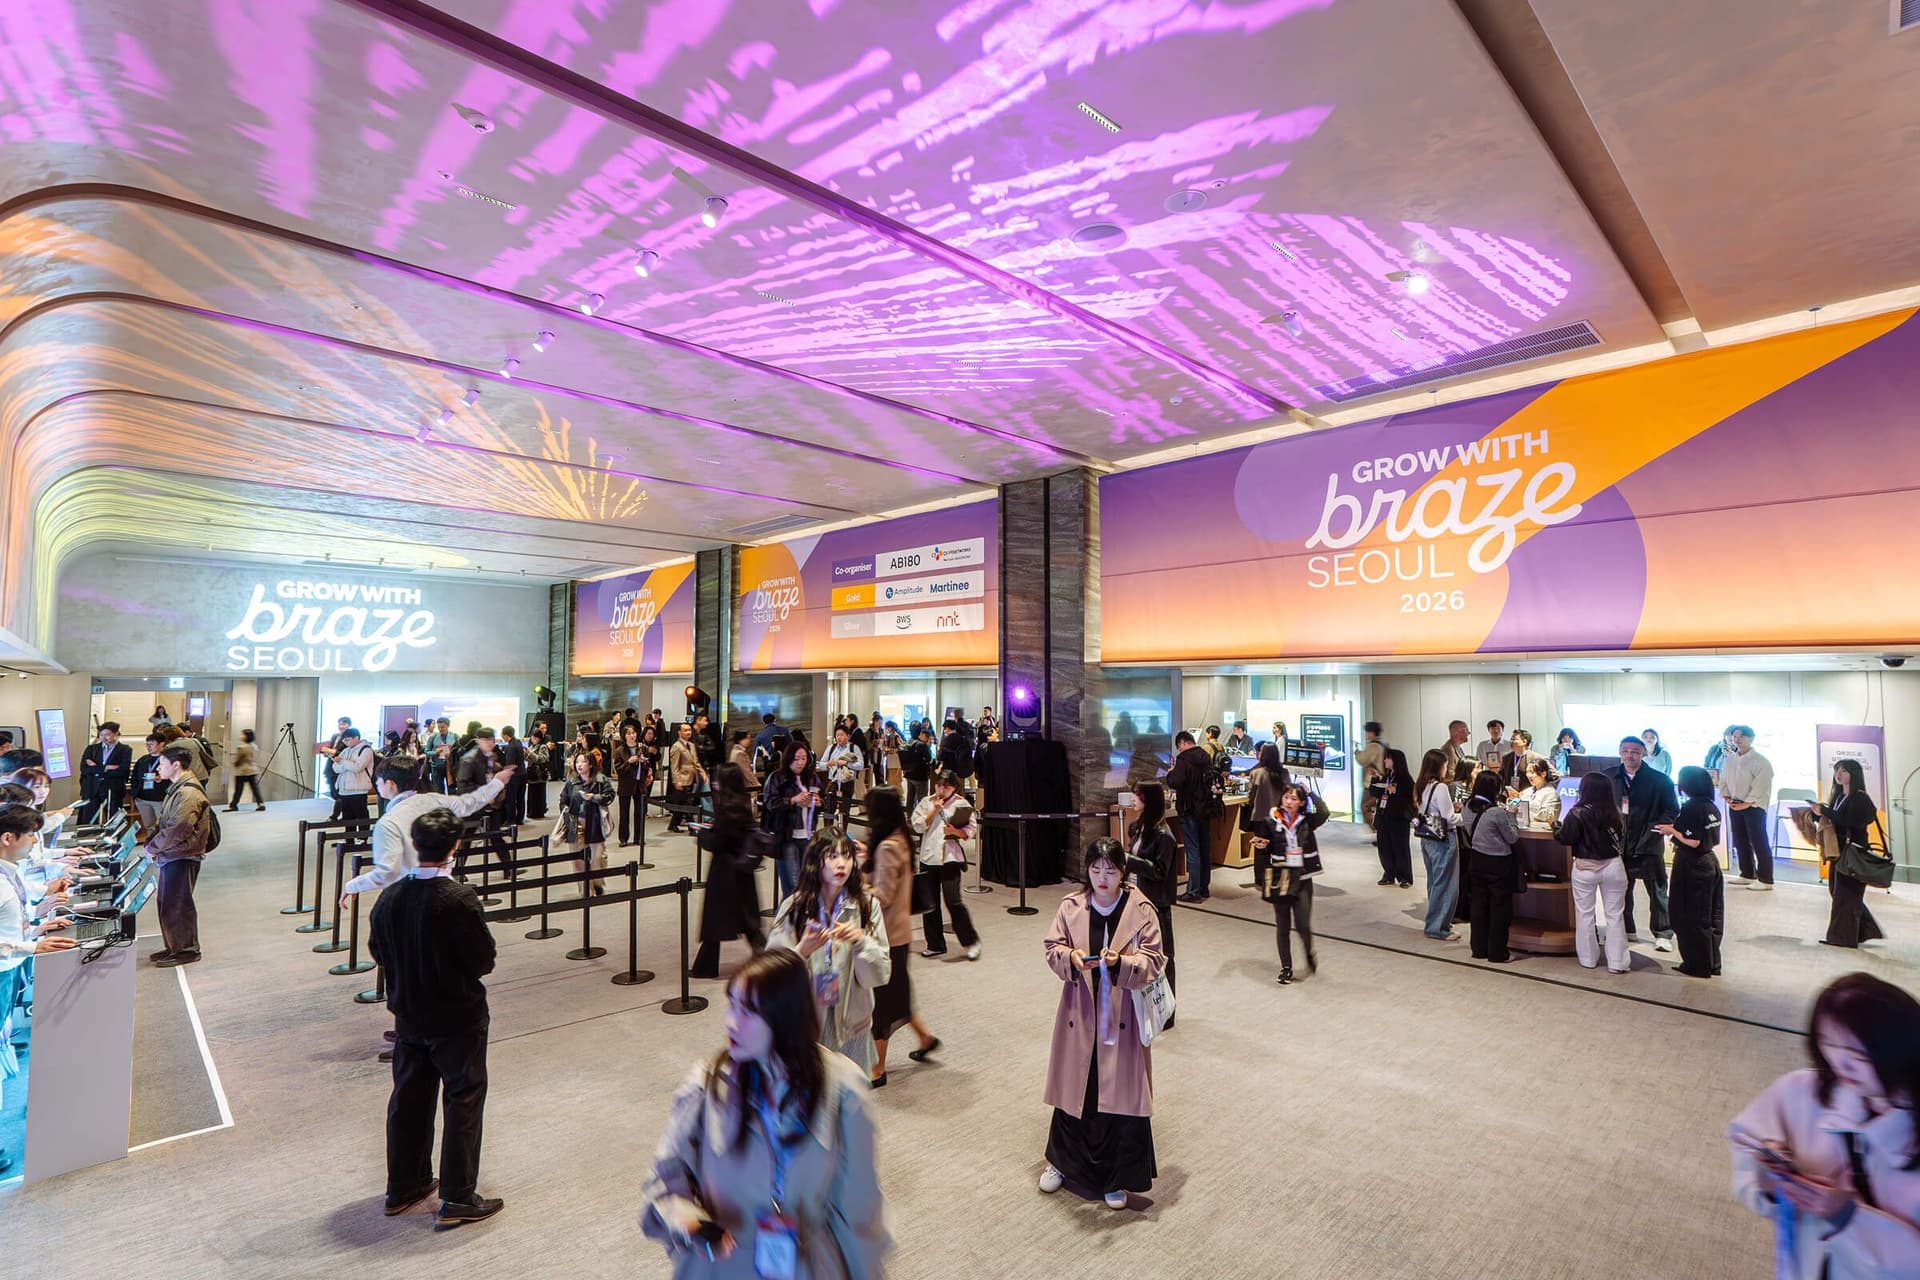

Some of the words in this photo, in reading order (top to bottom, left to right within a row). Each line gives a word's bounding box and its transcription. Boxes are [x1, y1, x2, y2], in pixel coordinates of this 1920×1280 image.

[1351, 445, 1450, 484] GROW
[1455, 429, 1549, 467] WITH
[1304, 461, 1583, 573] braze
[835, 563, 873, 576] Co-organiser
[890, 554, 921, 570] AB180
[1306, 543, 1455, 589] SEOUL
[276, 580, 359, 600] GROW
[360, 585, 421, 605] WITH
[762, 580, 779, 589] GROW
[780, 576, 796, 586] WITH
[894, 586, 924, 596] Amplitude
[930, 581, 969, 593] Martinee
[618, 591, 635, 602] GROW
[752, 583, 800, 621] braze
[1400, 590, 1465, 614] 2026
[225, 583, 437, 673] braze
[609, 596, 656, 642] braze
[752, 610, 780, 624] SEOUL
[609, 630, 635, 646] SEOUL
[226, 645, 353, 672] SEOUL
